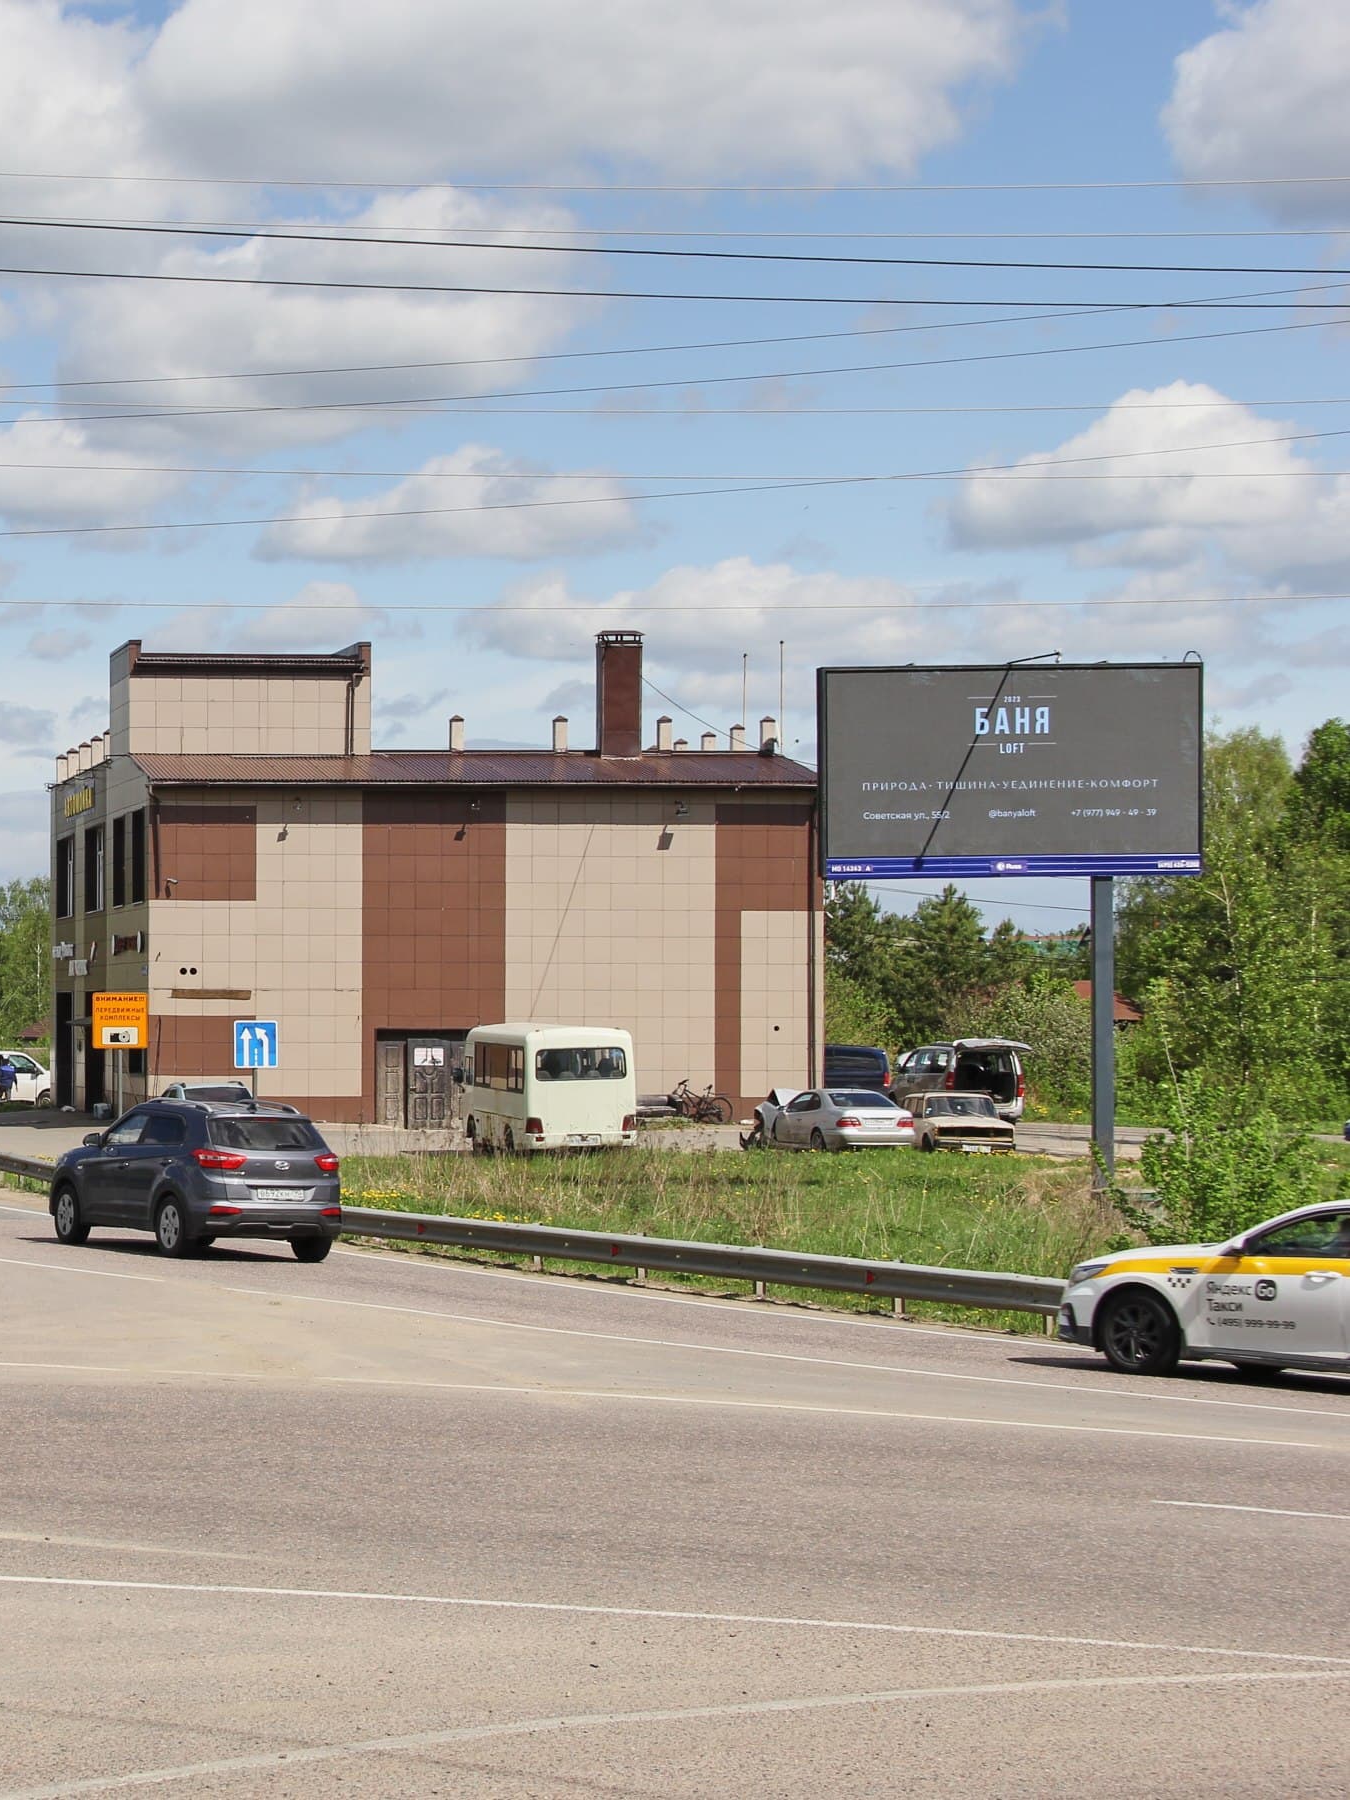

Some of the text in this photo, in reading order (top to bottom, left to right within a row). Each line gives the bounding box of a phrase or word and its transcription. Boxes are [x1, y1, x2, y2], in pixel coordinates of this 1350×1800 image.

[975, 706, 1050, 735] БАНЯ
[999, 743, 1025, 754] LOFT
[863, 811, 911, 820] Советская
[988, 808, 1036, 819] @banyaloft
[1083, 808, 1103, 818] (977)
[1206, 1281, 1276, 1298] Яндекс Go
[1206, 1298, 1243, 1312] Такси
[1244, 1318, 1296, 1330] 999-99-99
